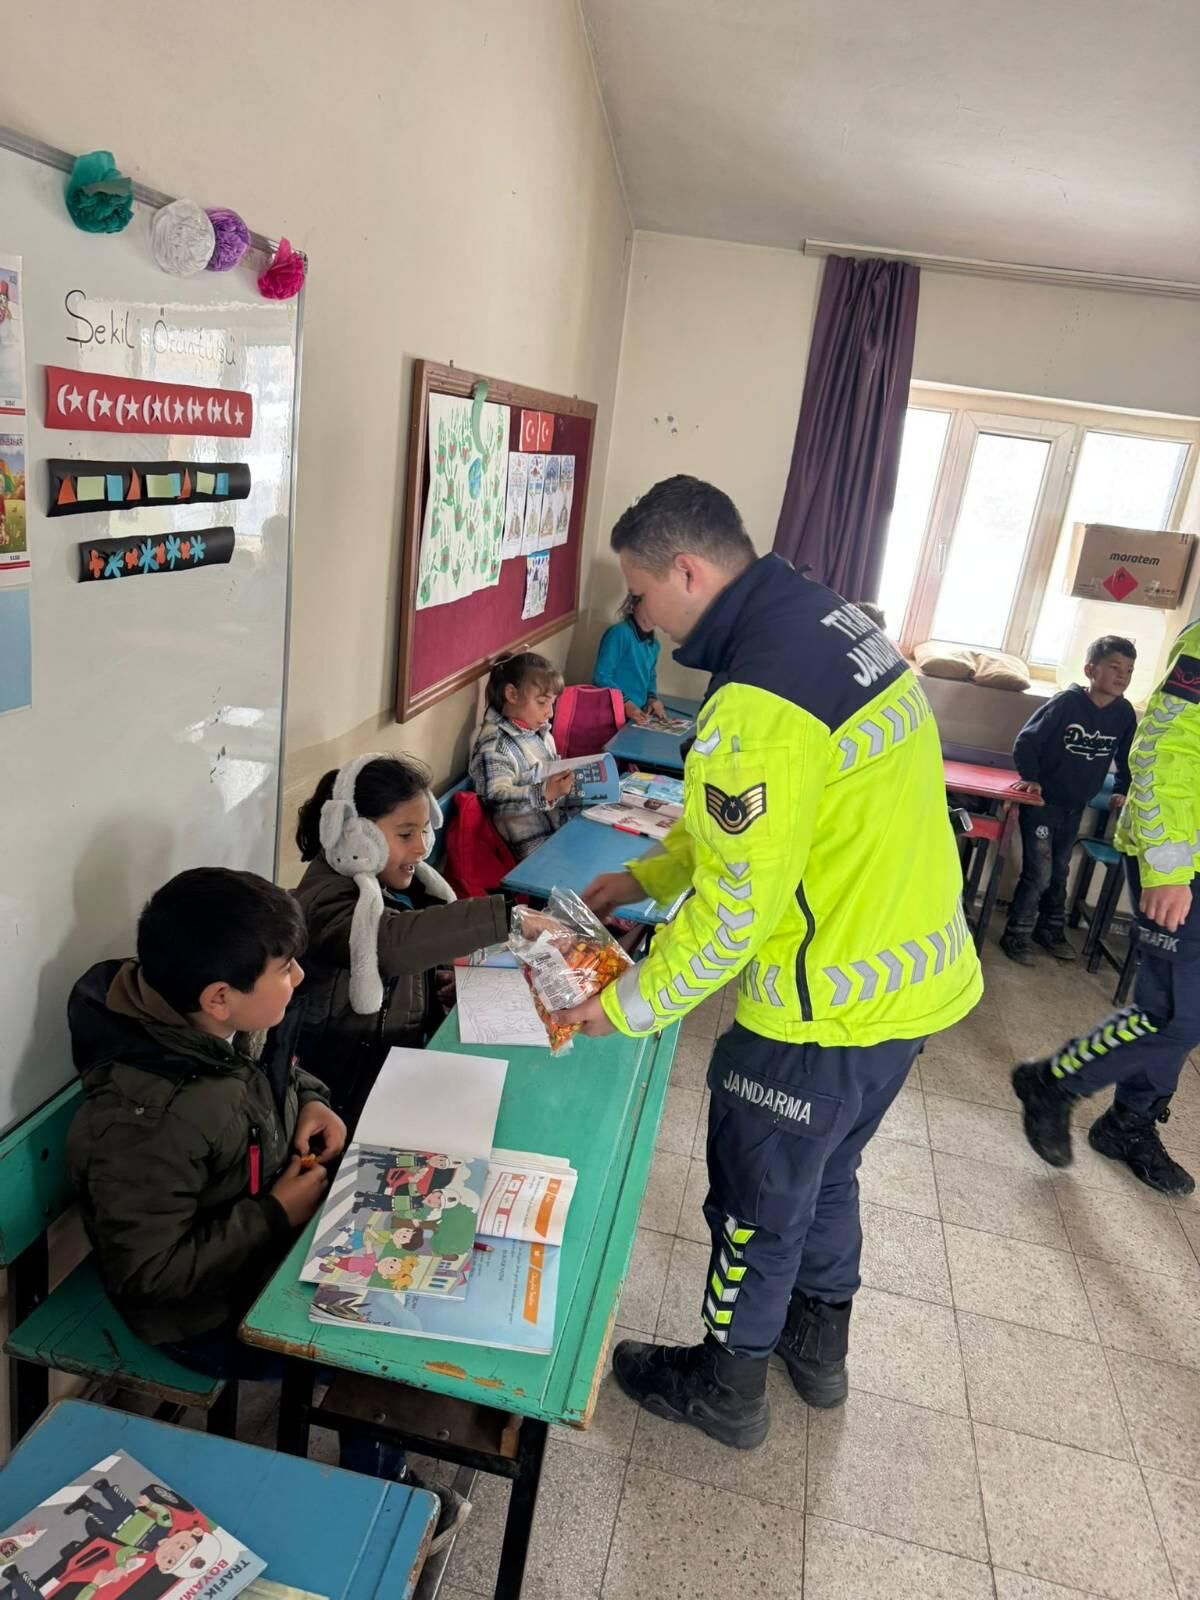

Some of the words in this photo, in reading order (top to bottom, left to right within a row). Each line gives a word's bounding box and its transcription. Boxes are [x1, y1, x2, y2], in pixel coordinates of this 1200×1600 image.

[1110, 552, 1160, 566] moratem
[723, 1069, 811, 1125] JANDARMA
[179, 1558, 229, 1600] BOYAM
